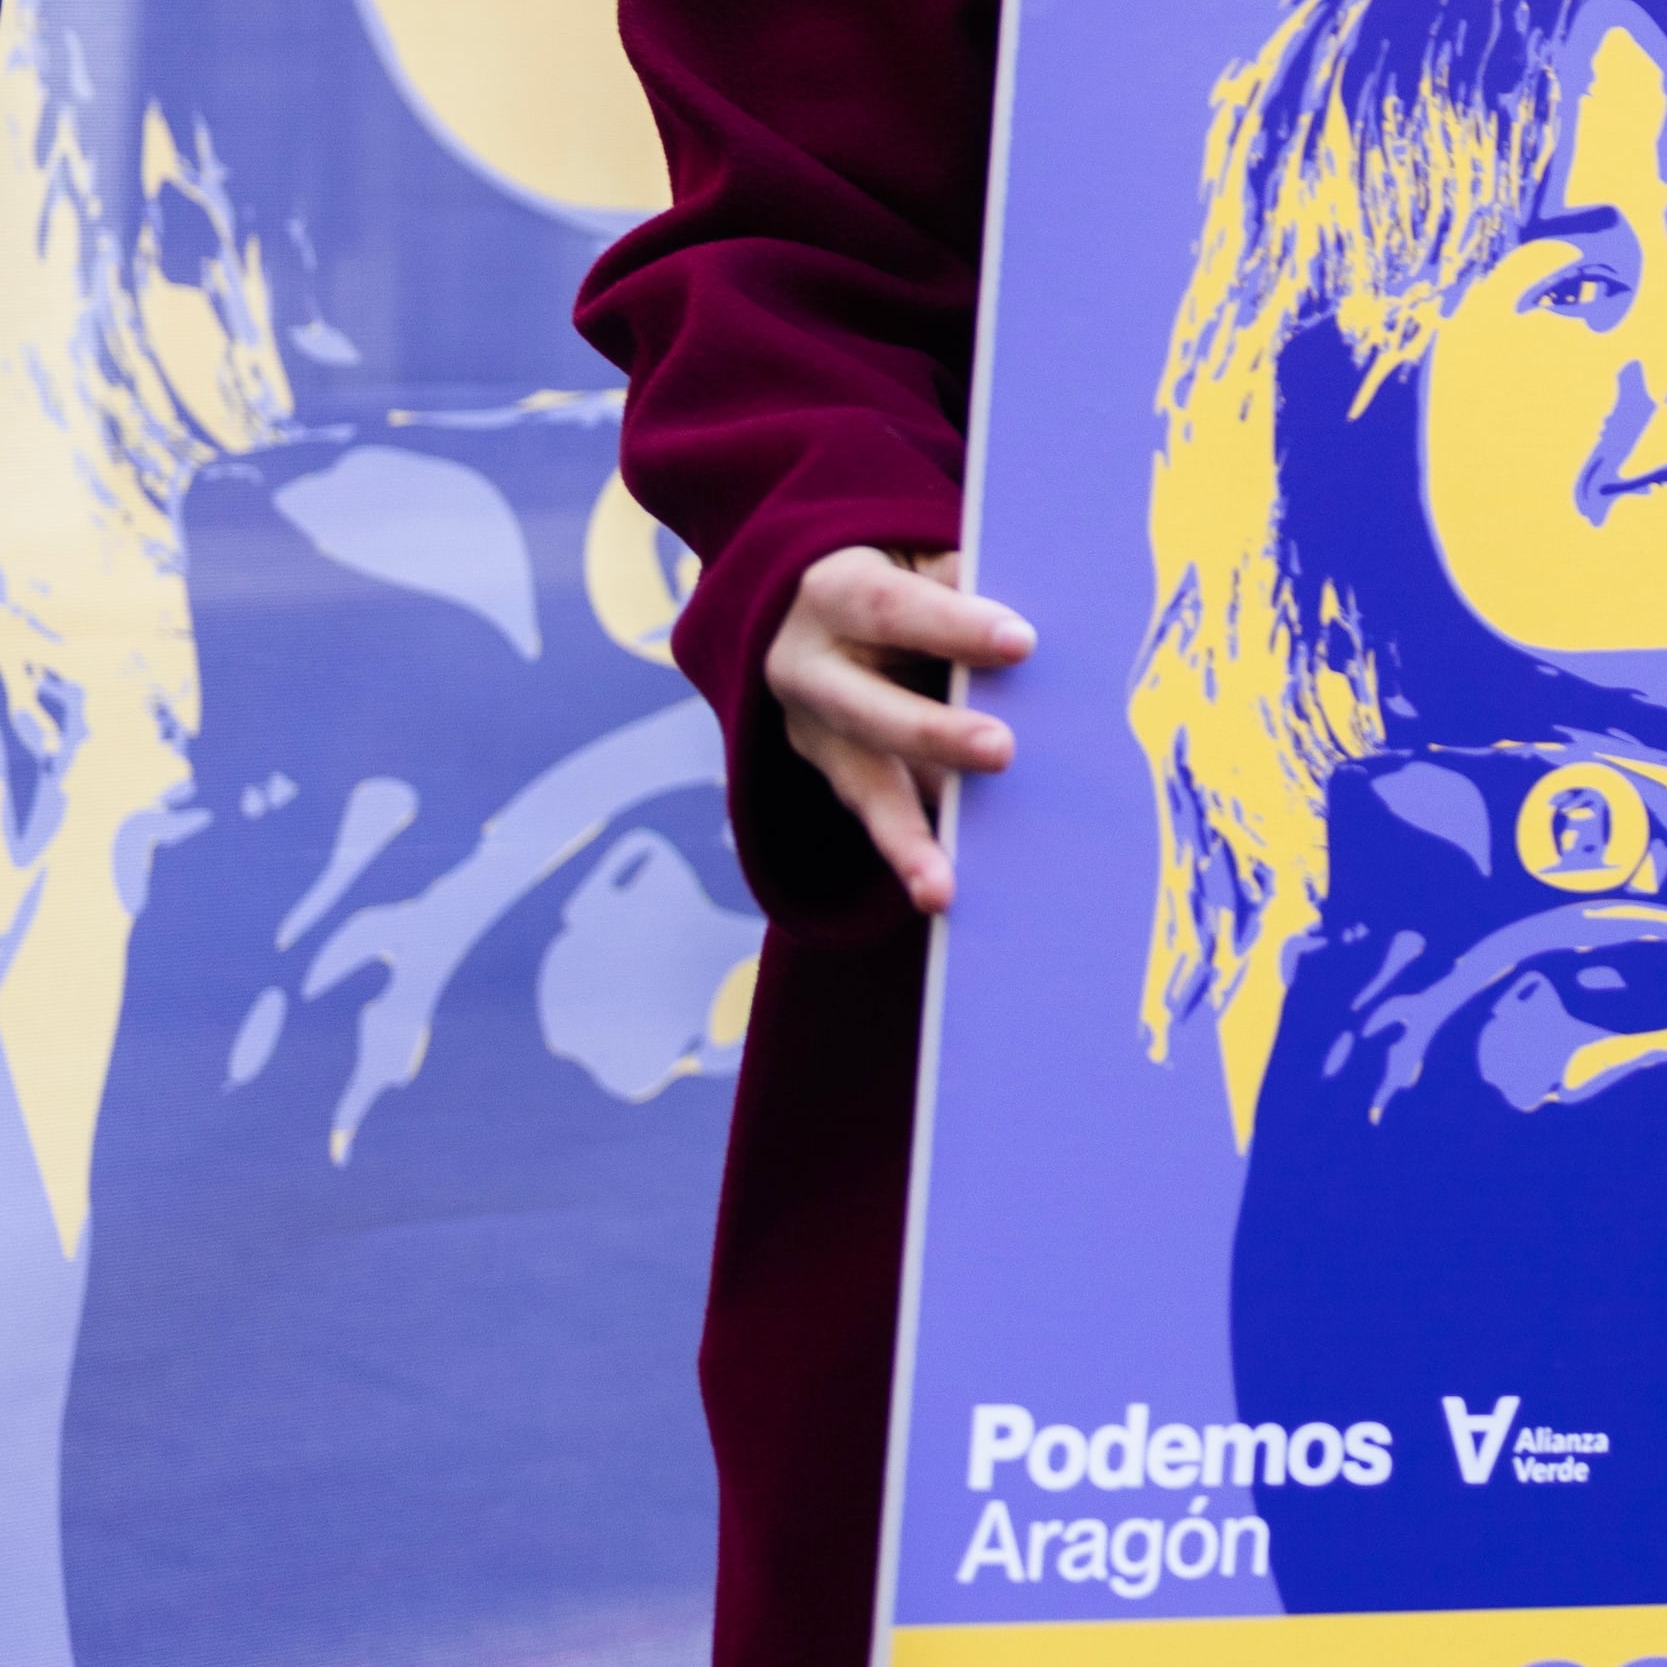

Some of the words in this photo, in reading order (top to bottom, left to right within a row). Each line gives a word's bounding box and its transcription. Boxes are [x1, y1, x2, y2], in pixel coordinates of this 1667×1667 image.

[967, 1402, 1394, 1492] Podemos
[1512, 1425, 1611, 1455] Alianza
[1512, 1454, 1591, 1484] Verde
[957, 1495, 1270, 1599] Aragón
